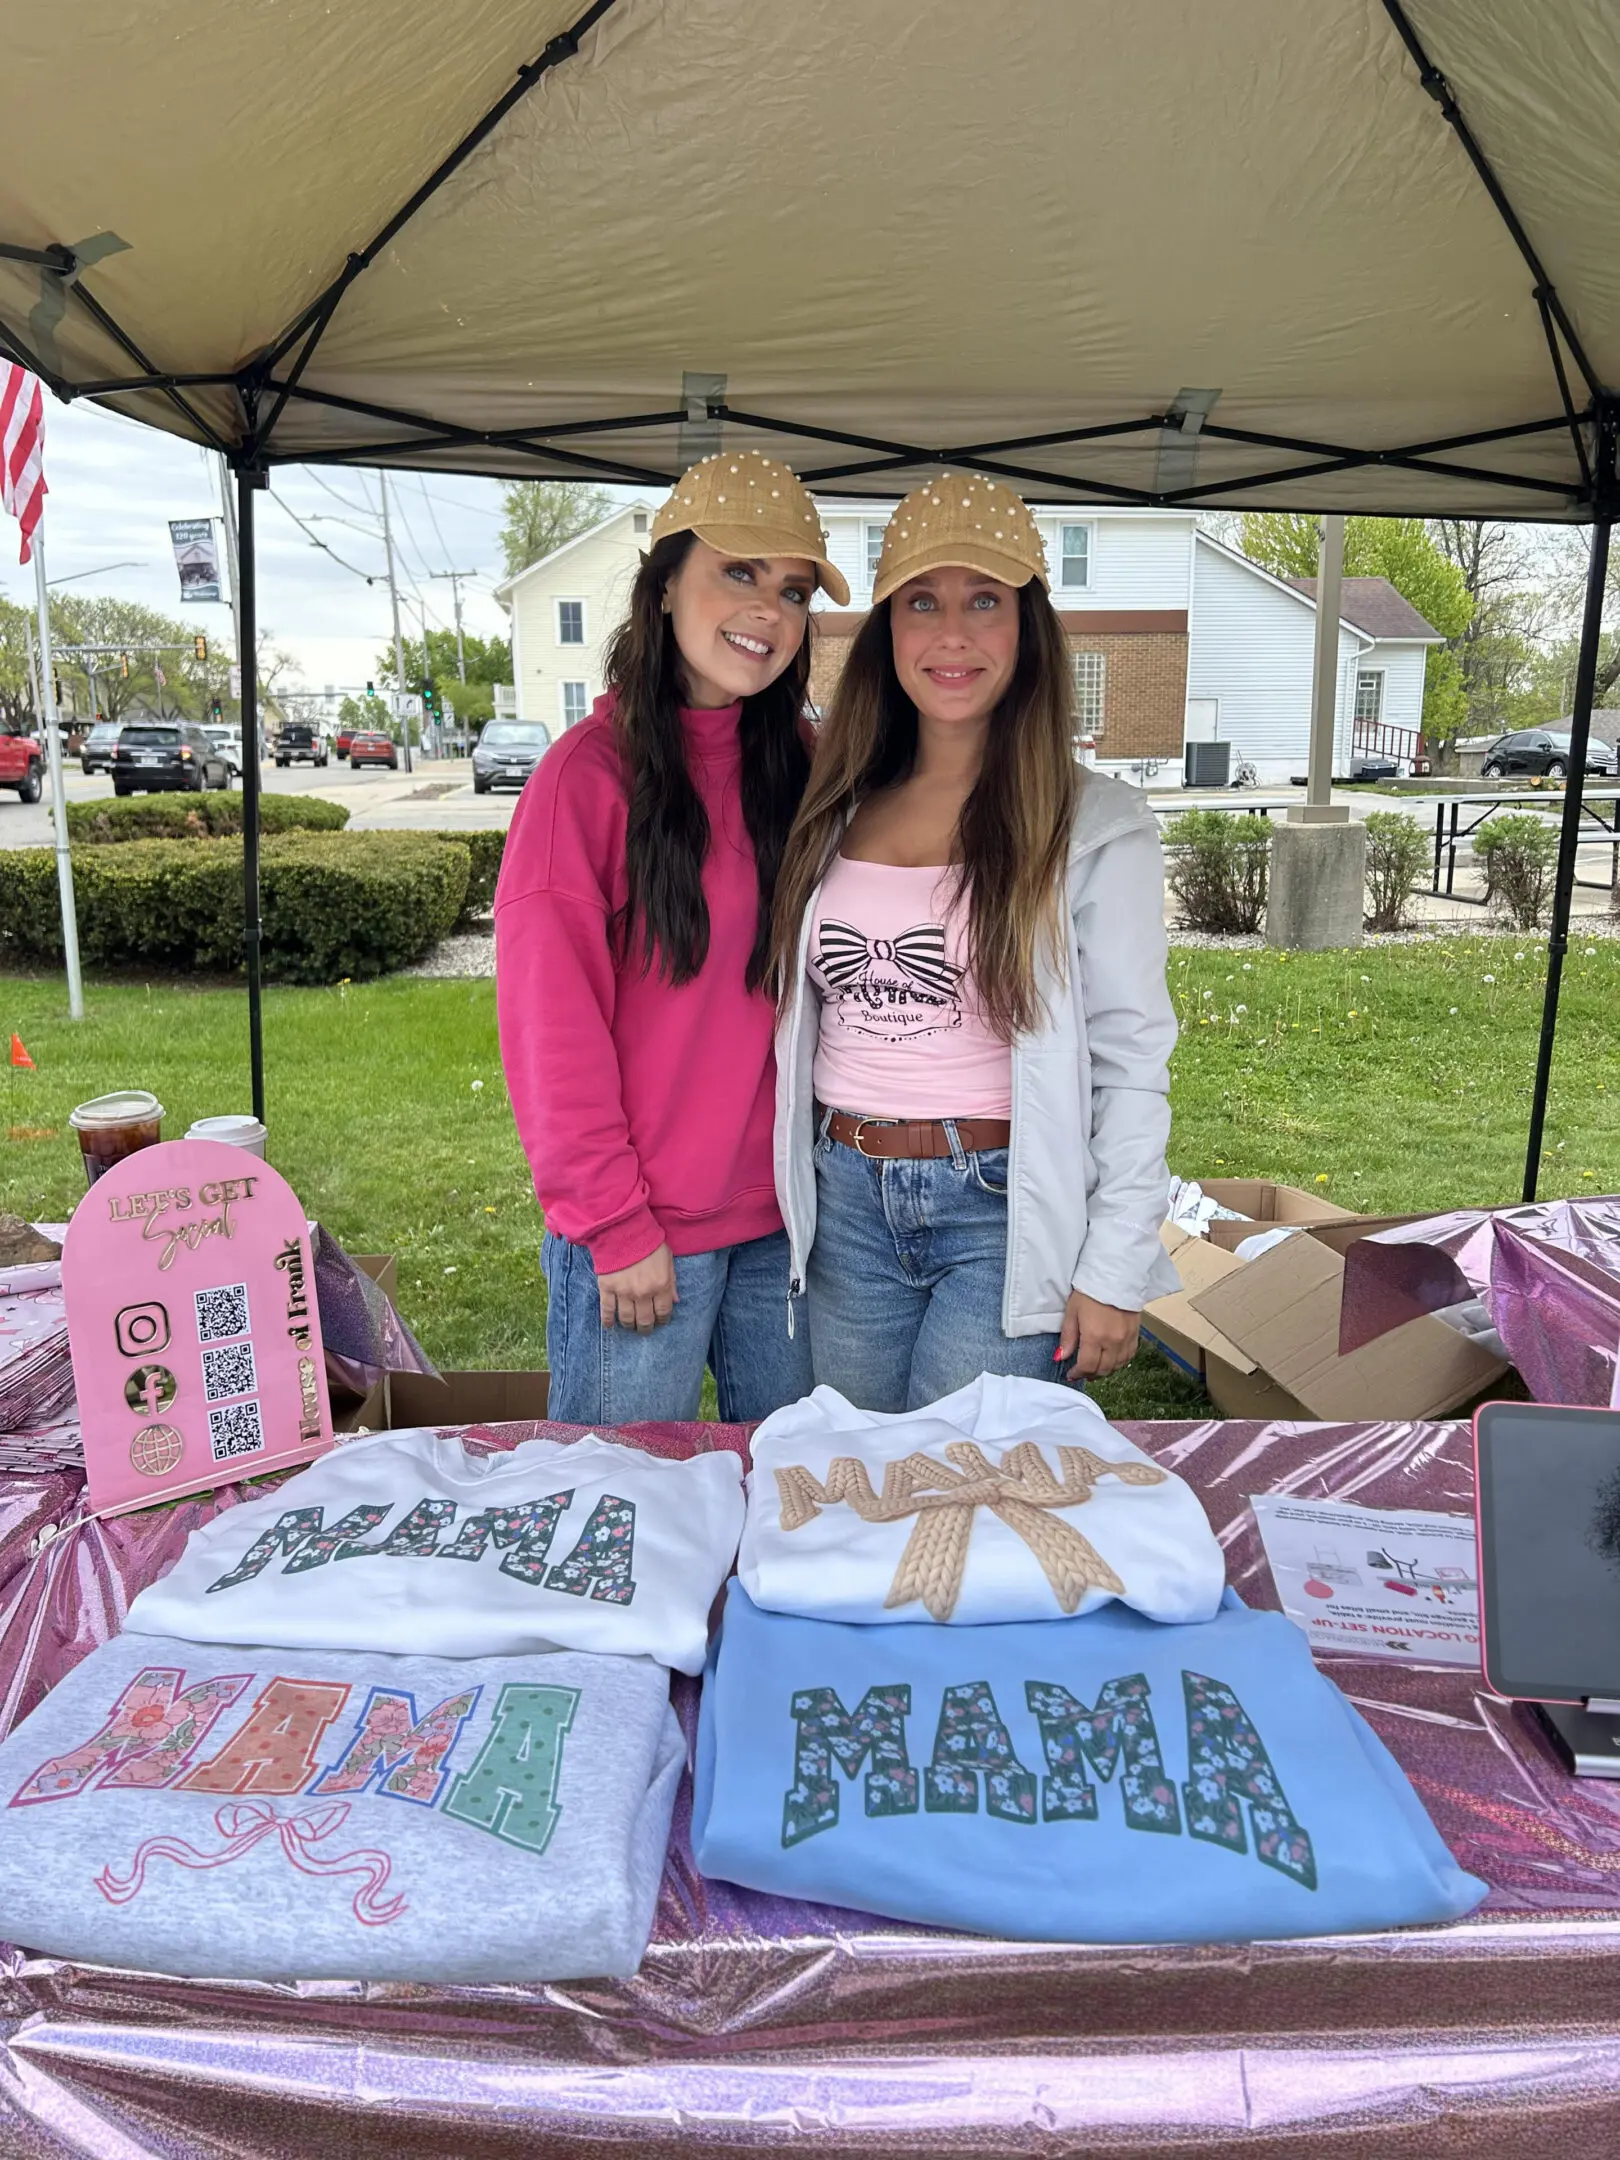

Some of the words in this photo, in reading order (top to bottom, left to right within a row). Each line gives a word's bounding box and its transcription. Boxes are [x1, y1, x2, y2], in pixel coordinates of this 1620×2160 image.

[859, 970, 898, 987] House
[902, 981, 914, 991] of
[861, 1010, 924, 1026] Boutique
[109, 1187, 192, 1222] LET'S
[198, 1176, 259, 1202] GET
[142, 1201, 238, 1271] Social
[273, 1237, 312, 1321] Frank
[288, 1323, 313, 1353] of
[296, 1357, 323, 1444] House
[206, 1488, 637, 1607] MAMA
[1312, 1618, 1369, 1632] SET-UP
[1371, 1624, 1462, 1644] LOCATION
[12, 1666, 583, 1857] MAMA
[781, 1670, 1318, 1891] MAMA
